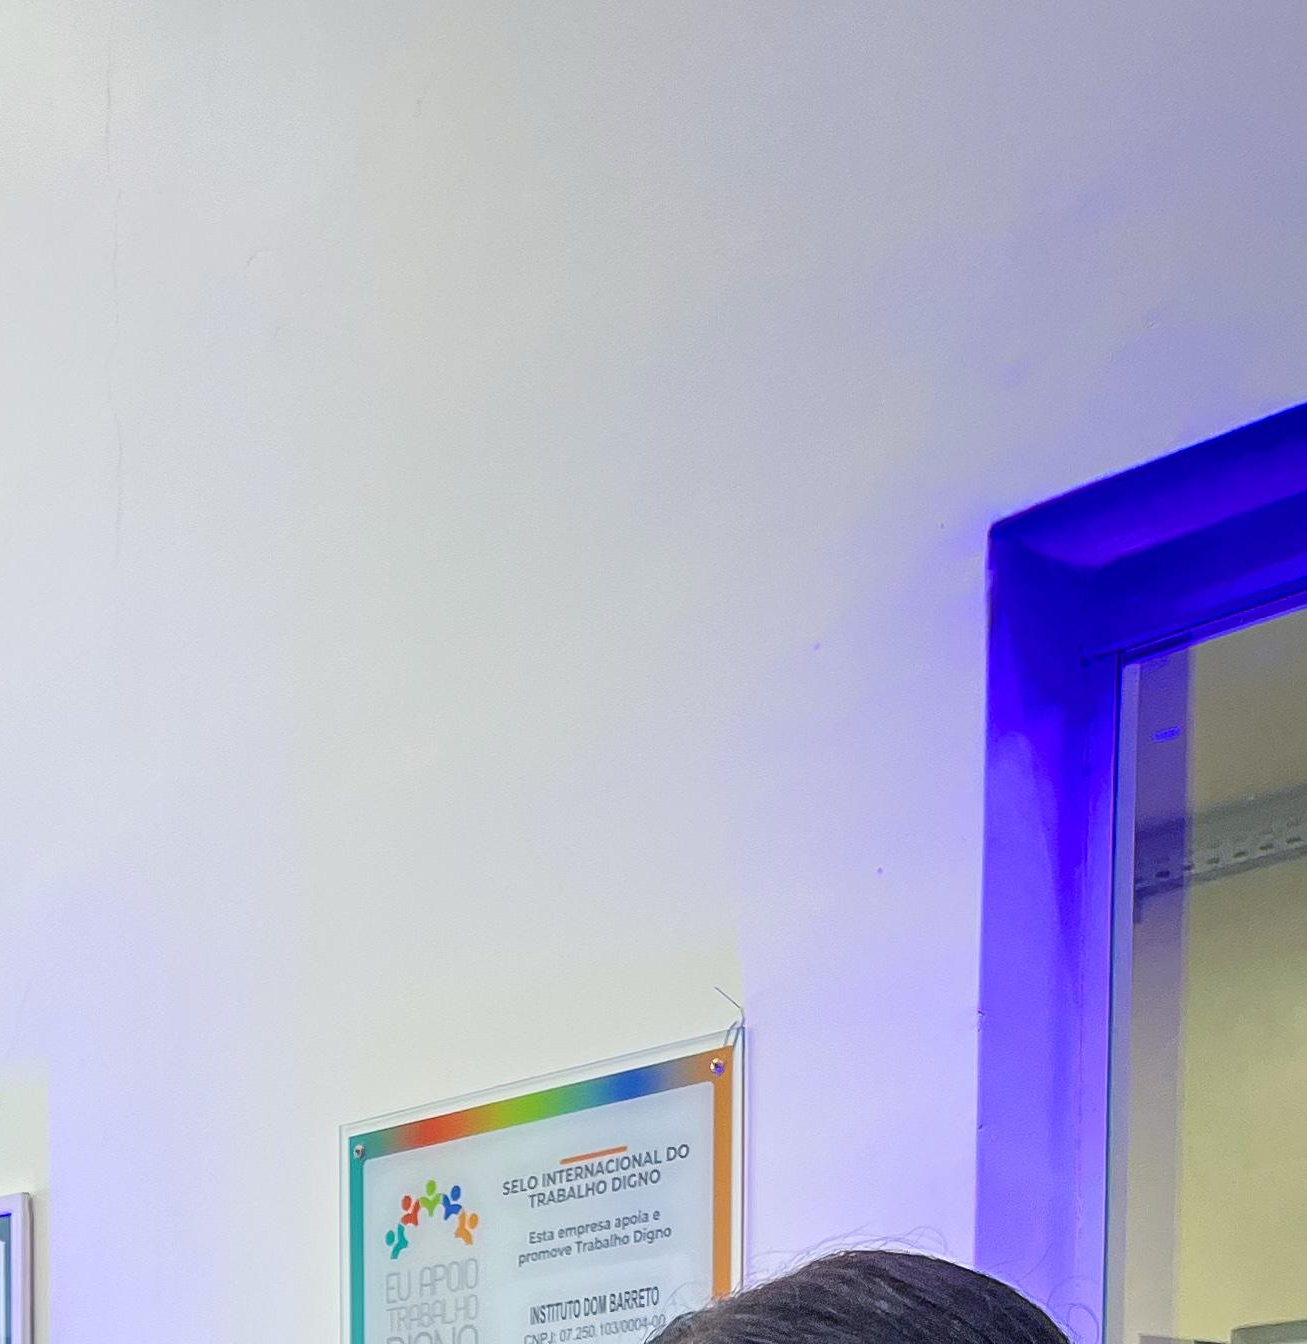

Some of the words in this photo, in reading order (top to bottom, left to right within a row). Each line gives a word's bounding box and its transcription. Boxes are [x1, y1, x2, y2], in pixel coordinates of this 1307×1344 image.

[502, 1176, 538, 1196] SELO
[542, 1151, 662, 1188] INTERNACIONAL
[666, 1143, 690, 1162] DO
[528, 1180, 607, 1208] TRABALHO
[612, 1169, 662, 1193] DIGNO
[518, 1245, 572, 1267] promove
[575, 1234, 630, 1254] Trabalho
[633, 1226, 672, 1245] Digno
[529, 1231, 555, 1245] Esta
[558, 1219, 611, 1239] empresa
[615, 1210, 649, 1229] apoia
[652, 1211, 662, 1221] e
[386, 1271, 411, 1304] EU
[419, 1258, 479, 1297] APOIO
[386, 1294, 479, 1332] TRABALHO
[530, 1300, 581, 1325] INSTITUTO
[583, 1297, 607, 1317] DOM
[609, 1286, 660, 1313] BARRETO
